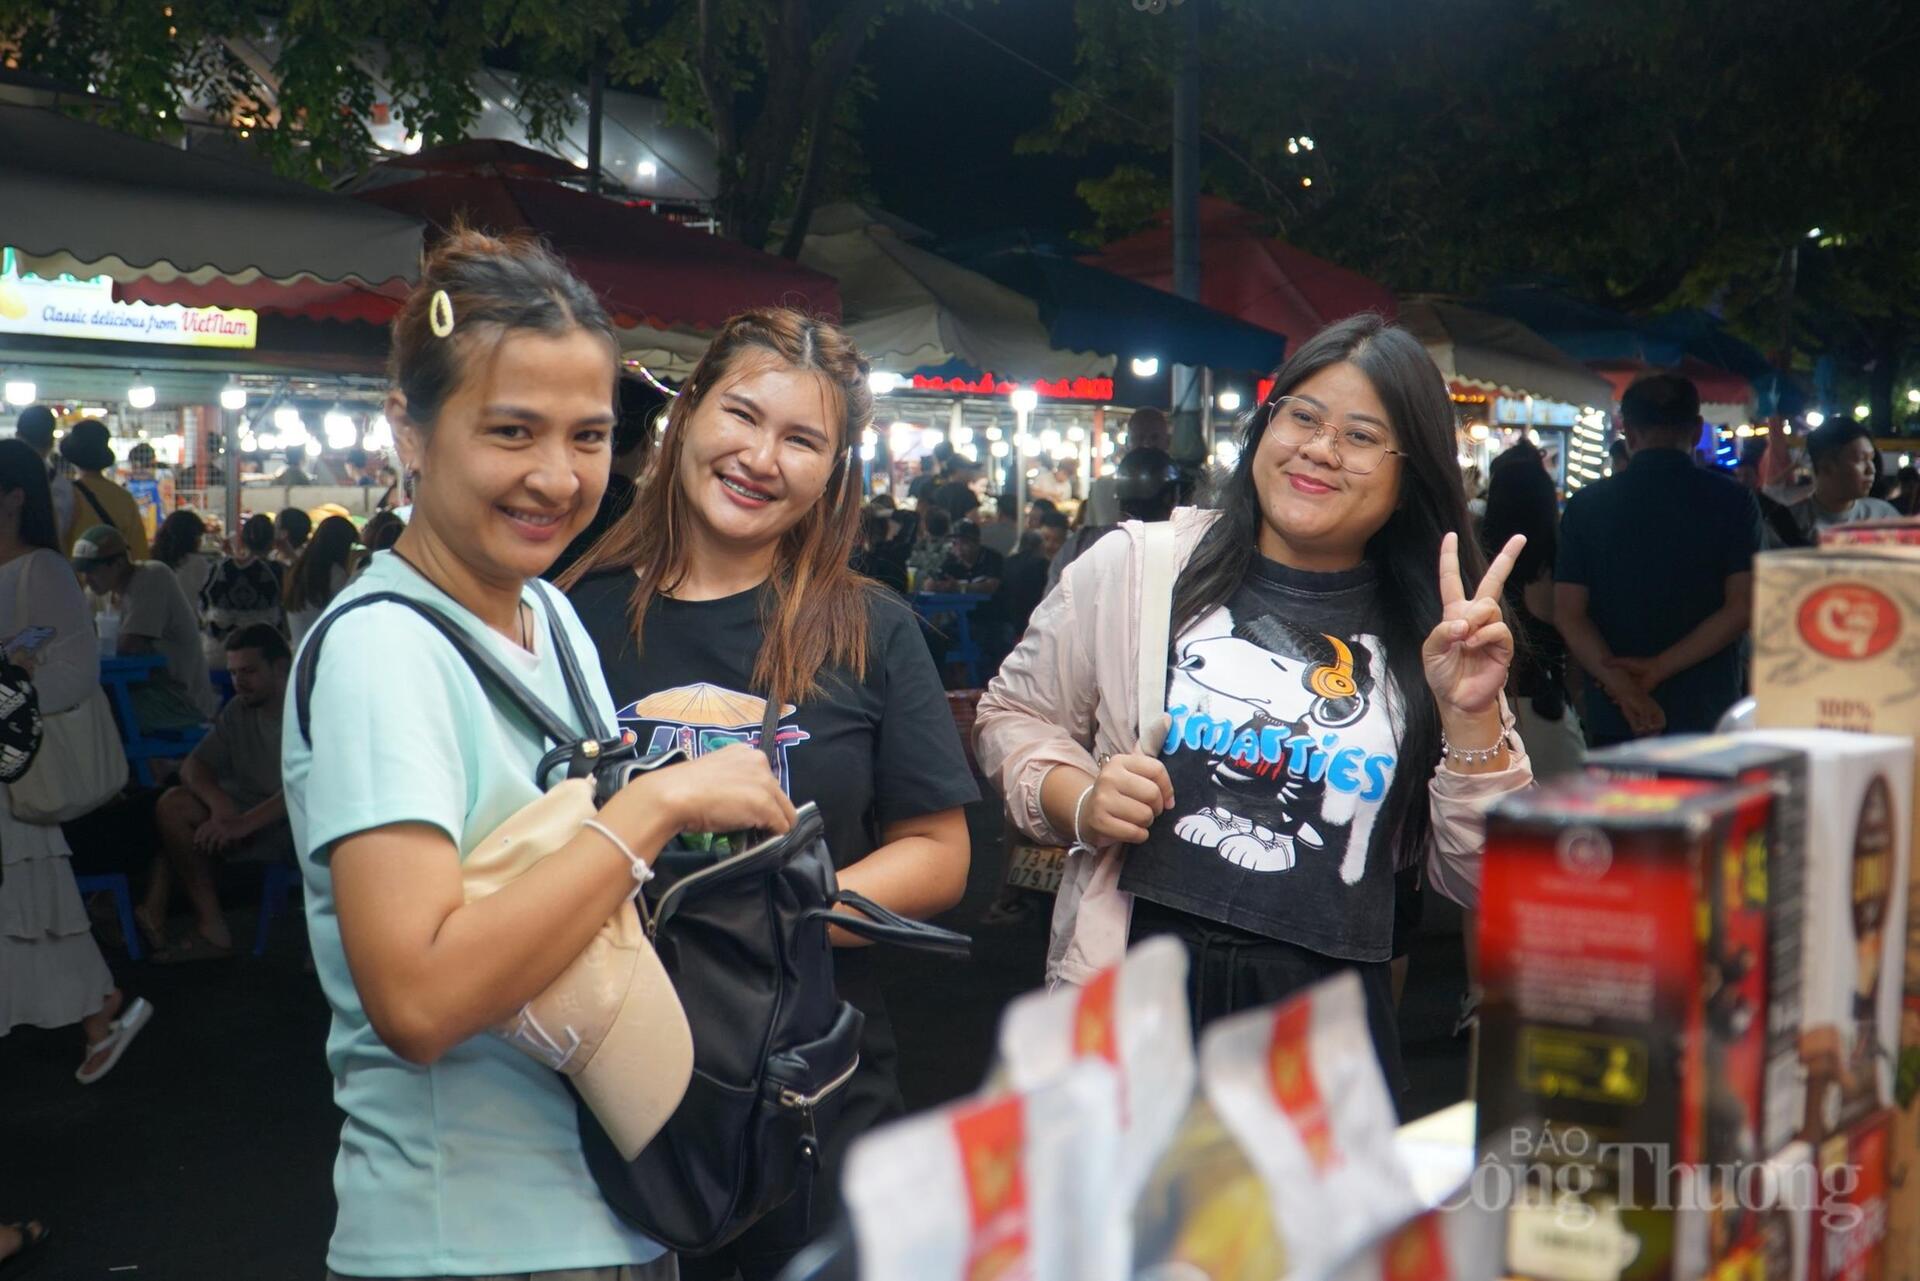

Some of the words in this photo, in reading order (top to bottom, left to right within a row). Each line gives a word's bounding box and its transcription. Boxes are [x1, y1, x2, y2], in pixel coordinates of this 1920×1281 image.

[43, 304, 87, 324] Classic
[91, 309, 145, 328] delicious
[145, 314, 177, 334] from
